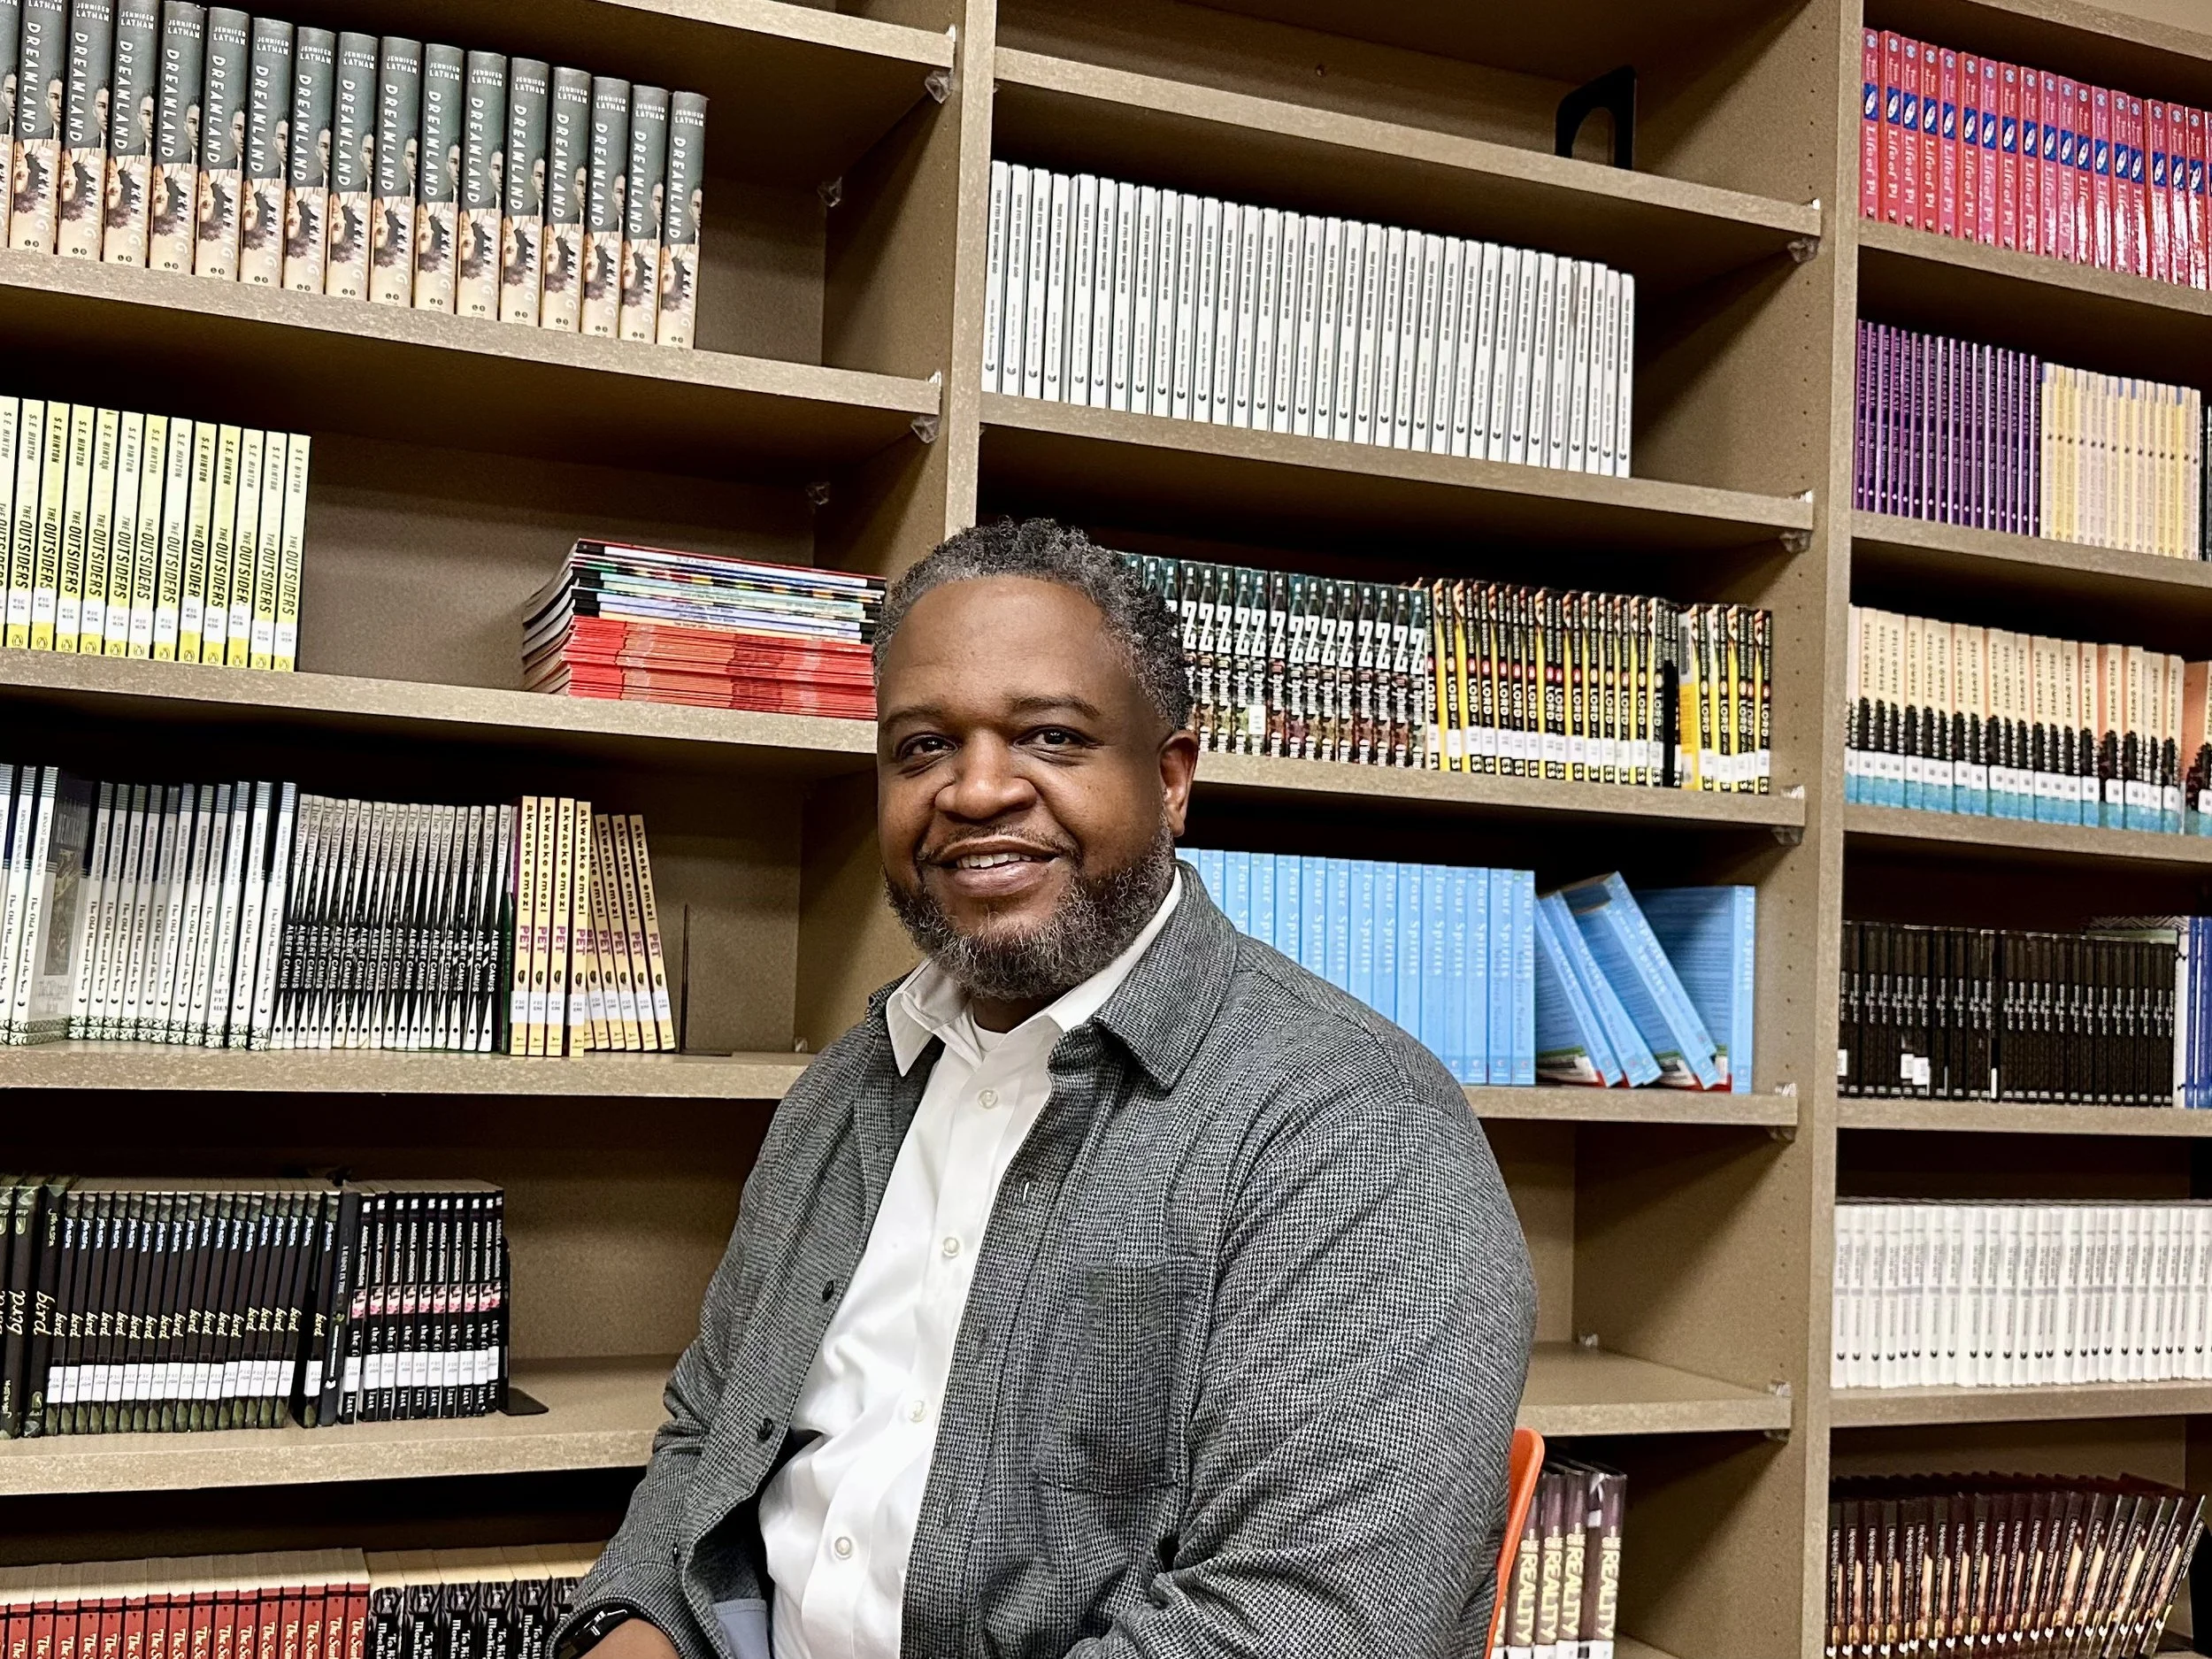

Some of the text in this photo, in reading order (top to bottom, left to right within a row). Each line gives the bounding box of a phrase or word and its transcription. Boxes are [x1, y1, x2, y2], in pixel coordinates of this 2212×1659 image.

[121, 11, 155, 21] JENNIFER
[121, 19, 154, 30] LATHAM
[214, 26, 246, 37] JENNIFER
[213, 33, 245, 45] LATHAM
[300, 51, 332, 65] LATHAM
[301, 45, 332, 56] JENNIFER
[387, 56, 418, 66] JENNIFER
[22, 22, 41, 134] DREAMLAND
[69, 32, 88, 142] DREAMLAND
[387, 63, 417, 74] LATHAM
[515, 84, 545, 95] LATHAM
[516, 76, 545, 87] JENNIFER
[115, 41, 134, 150] DREAMLAND
[161, 49, 180, 157] DREAMLAND
[676, 109, 704, 118] JENNIFER
[250, 65, 268, 173] DREAMLAND
[294, 74, 311, 181] DREAMLAND
[337, 80, 356, 186] DREAMLAND
[675, 116, 703, 127] LATHAM
[425, 90, 442, 196] DREAMLAND
[467, 97, 484, 204] DREAMLAND
[510, 104, 527, 210] DREAMLAND
[1866, 126, 1876, 157] Life
[1925, 140, 1934, 170] Life
[629, 130, 647, 234] DREAMLAND
[669, 136, 686, 238] DREAMLAND
[1965, 150, 1974, 180] Life
[51, 434, 60, 463] HINTON
[199, 454, 208, 482] HINTON
[224, 456, 233, 485] HINTON
[16, 505, 33, 588] THE OUTSIDERS
[65, 526, 81, 594] OUTSIDERS
[89, 529, 106, 596] OUTSIDERS
[113, 532, 131, 599] OUTSIDERS
[137, 533, 155, 600] OUTSIDERS
[163, 536, 180, 603] OUTSIDERS
[211, 542, 228, 608] OUTSIDERS
[259, 548, 275, 613] OUTSIDERS
[282, 549, 299, 616] OUTSIDERS
[1513, 683, 1522, 718] LORD
[1528, 685, 1537, 719] LORD
[1546, 687, 1555, 720] LORD
[301, 803, 310, 820] The
[348, 805, 357, 824] The
[374, 808, 383, 825] The
[525, 805, 534, 865] akwaeke
[542, 806, 552, 866] akwaeke
[579, 810, 588, 869] akwaeke
[635, 825, 655, 921] akwaeke emezi
[519, 926, 530, 953] PET
[537, 926, 548, 954] PET
[577, 929, 586, 956] PET
[649, 933, 661, 957] PET
[1361, 874, 1373, 973] Four Spirits
[1384, 874, 1396, 973] Four Spirits
[1408, 877, 1420, 975] Four Spirits
[1432, 877, 1445, 976] Four Spirits
[280, 925, 294, 988] ALBERT CAMUS
[342, 927, 355, 990] ALBERT CAMUS
[472, 930, 484, 992] ALBERT CAMUS
[488, 930, 499, 993] ALBERT CAMUS
[6, 1290, 26, 1334] bird
[34, 1291, 55, 1336] bird
[55, 1312, 67, 1336] bird
[85, 1312, 98, 1336] bird
[115, 1311, 128, 1336] bird
[314, 1313, 327, 1337] bird
[1517, 1555, 1538, 1643] REALITY
[1540, 1551, 1562, 1640] REALITY
[1563, 1548, 1584, 1636] REALITY
[1599, 1551, 1619, 1638] REALITY
[286, 1620, 298, 1639] The
[330, 1617, 342, 1636] The
[352, 1617, 364, 1636] The
[462, 1630, 471, 1644] To
[534, 1625, 542, 1639] To
